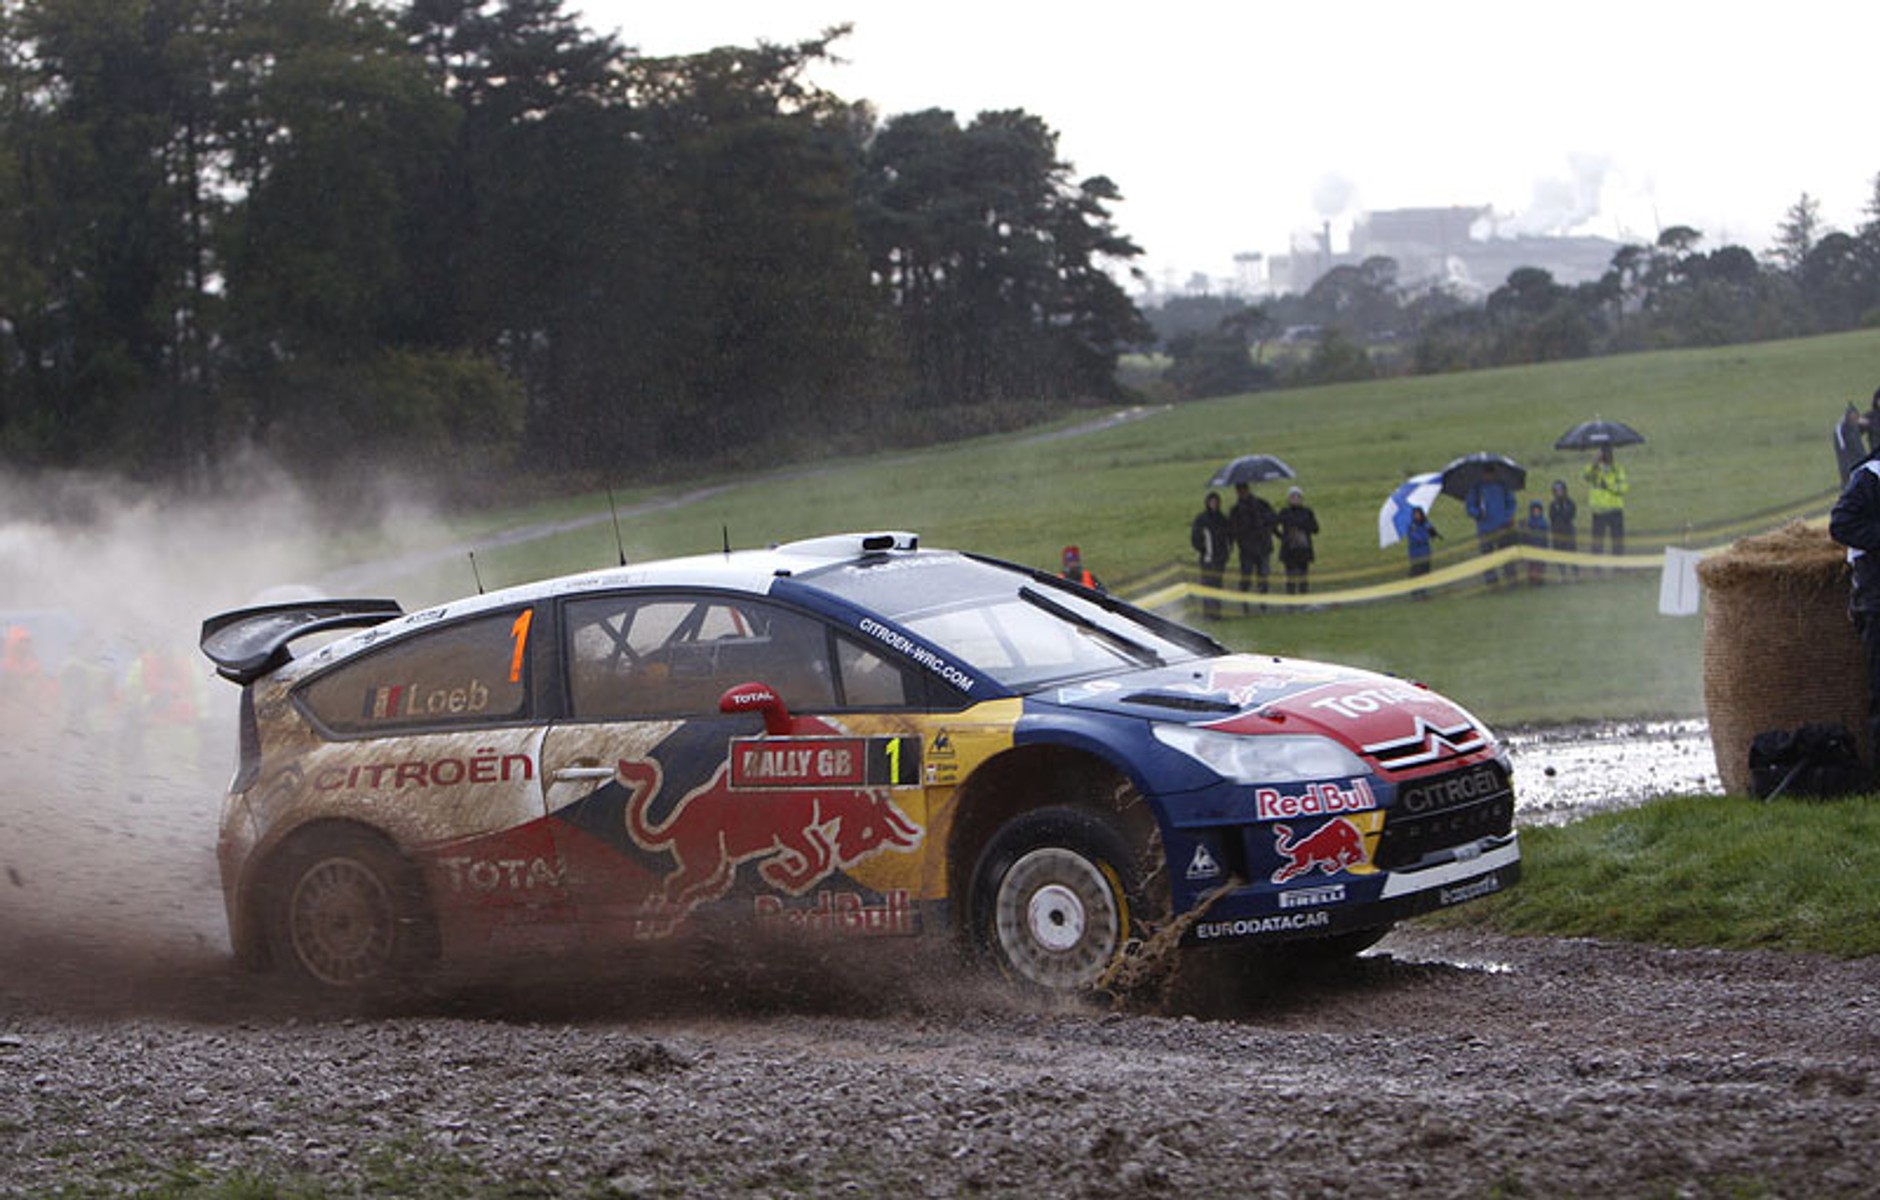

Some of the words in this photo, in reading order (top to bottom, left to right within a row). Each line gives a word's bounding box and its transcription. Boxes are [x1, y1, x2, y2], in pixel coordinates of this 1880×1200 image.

[509, 608, 533, 683] 1
[859, 617, 974, 692] CITROEN-WRC.COM
[405, 678, 489, 716] Loeb
[731, 692, 774, 704] TOTAL
[743, 751, 812, 777] RALLY
[817, 749, 851, 776] GB
[885, 737, 900, 784] 1
[1256, 785, 1322, 820] Red
[1319, 777, 1376, 811] Bull
[834, 888, 911, 934] Bull
[1279, 884, 1345, 908] PIRELLI
[1196, 911, 1329, 938] EURODATACAR
